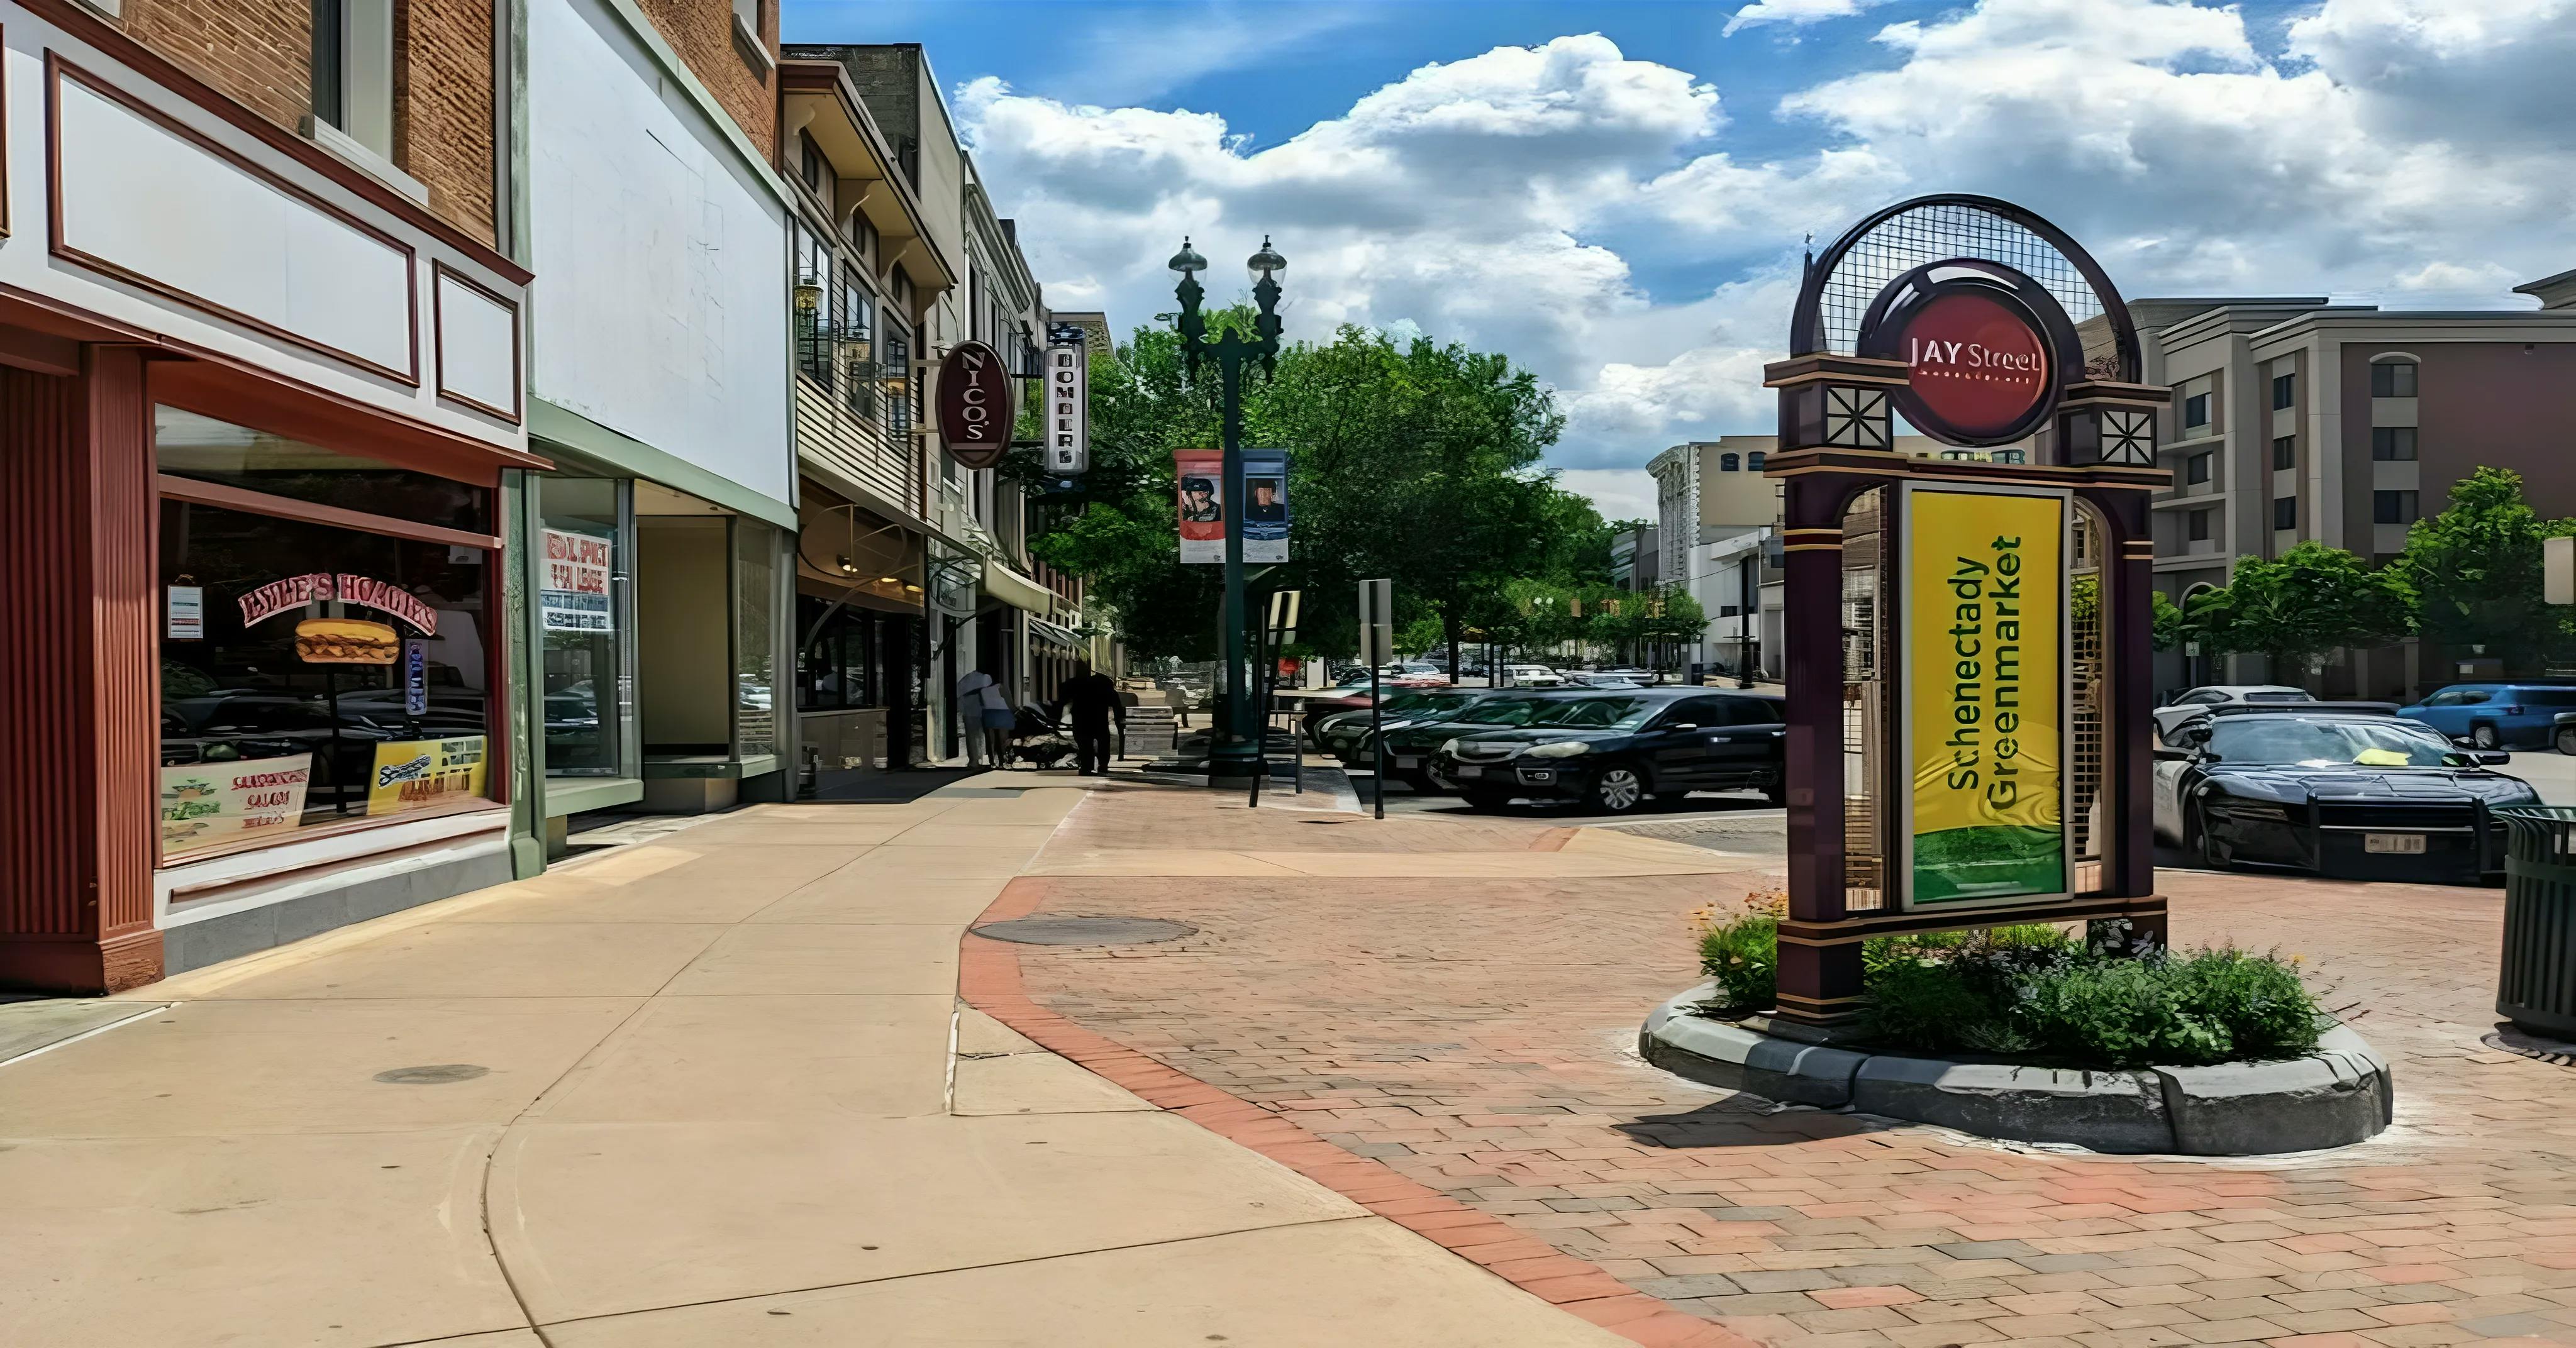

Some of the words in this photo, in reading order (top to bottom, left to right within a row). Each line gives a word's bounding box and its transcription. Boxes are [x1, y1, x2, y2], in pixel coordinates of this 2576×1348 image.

[962, 351, 989, 439] NICO'S
[1056, 353, 1074, 463] BOMBERS
[1909, 338, 1962, 367] JAY
[1968, 344, 2040, 371] Street
[1945, 556, 1989, 790] Schenectady
[1987, 535, 2021, 810] Greenmarket
